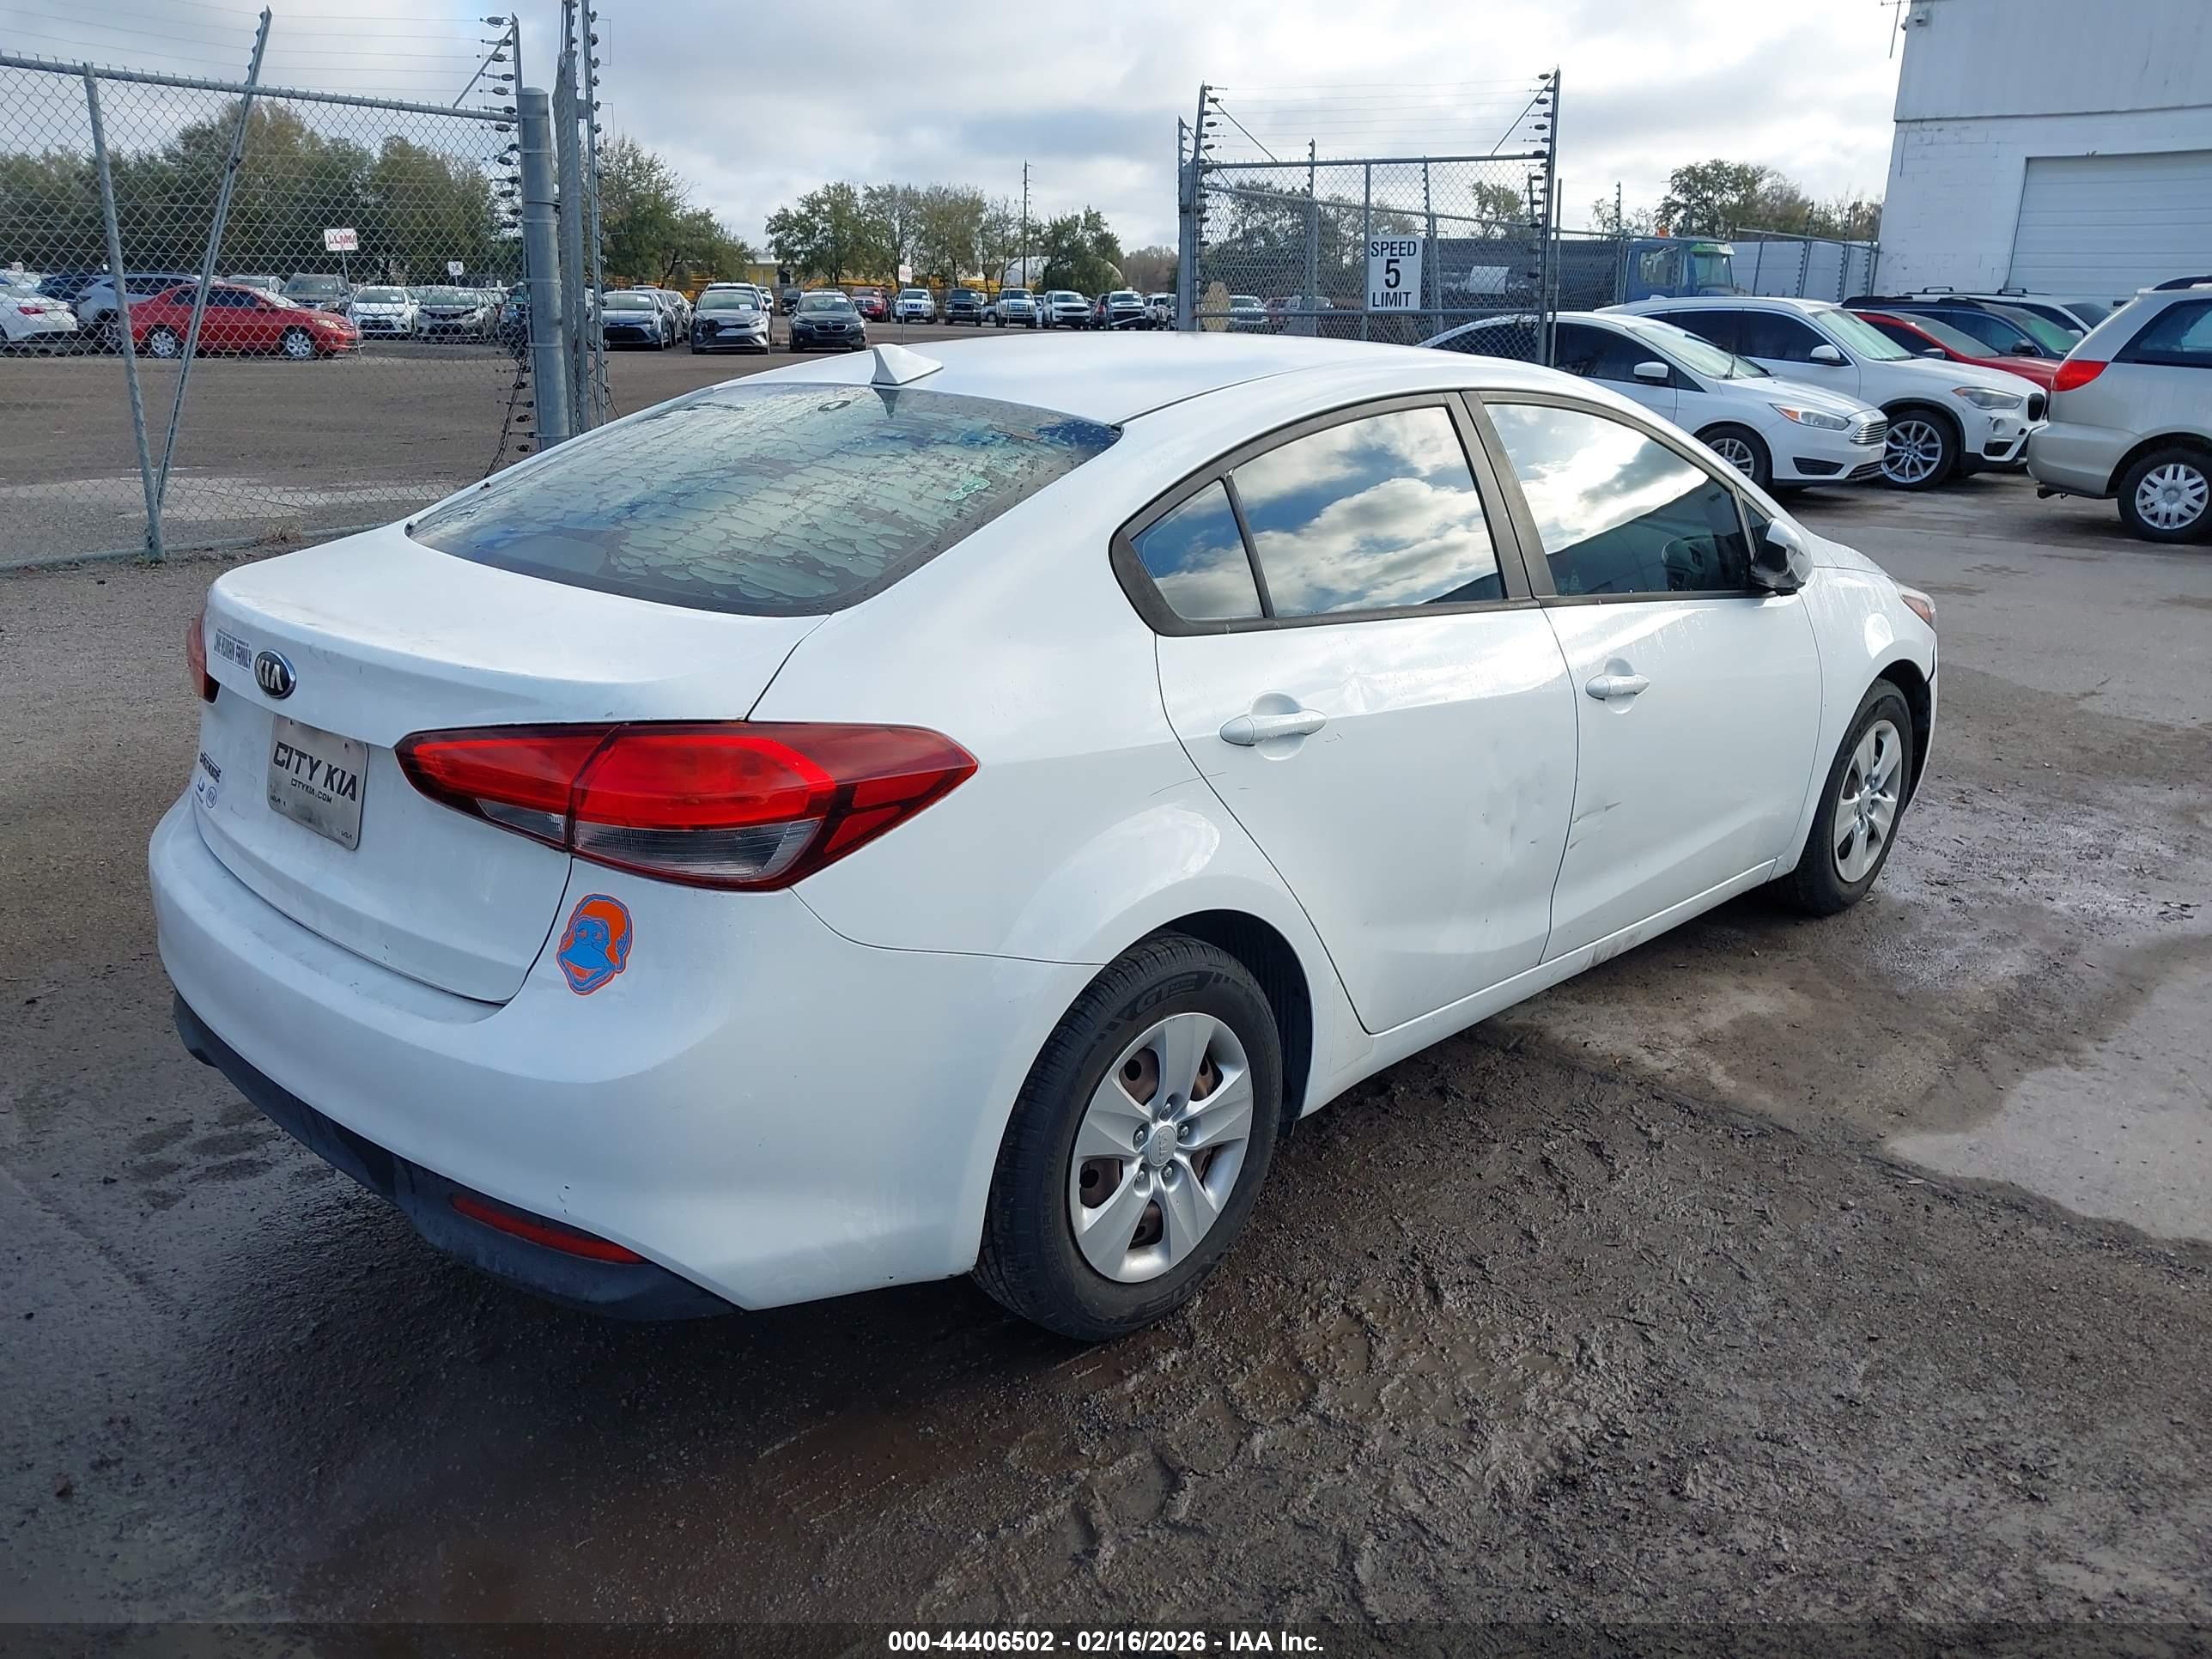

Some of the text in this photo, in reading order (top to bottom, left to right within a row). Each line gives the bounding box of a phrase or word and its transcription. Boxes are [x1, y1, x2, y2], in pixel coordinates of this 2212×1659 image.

[1370, 241, 1417, 257] SPEED
[1384, 258, 1401, 289] 5
[1372, 292, 1412, 307] LIMIT
[257, 657, 284, 692] KIA
[273, 740, 357, 802] CITY KIA
[290, 777, 333, 805] CITYKIA.COM
